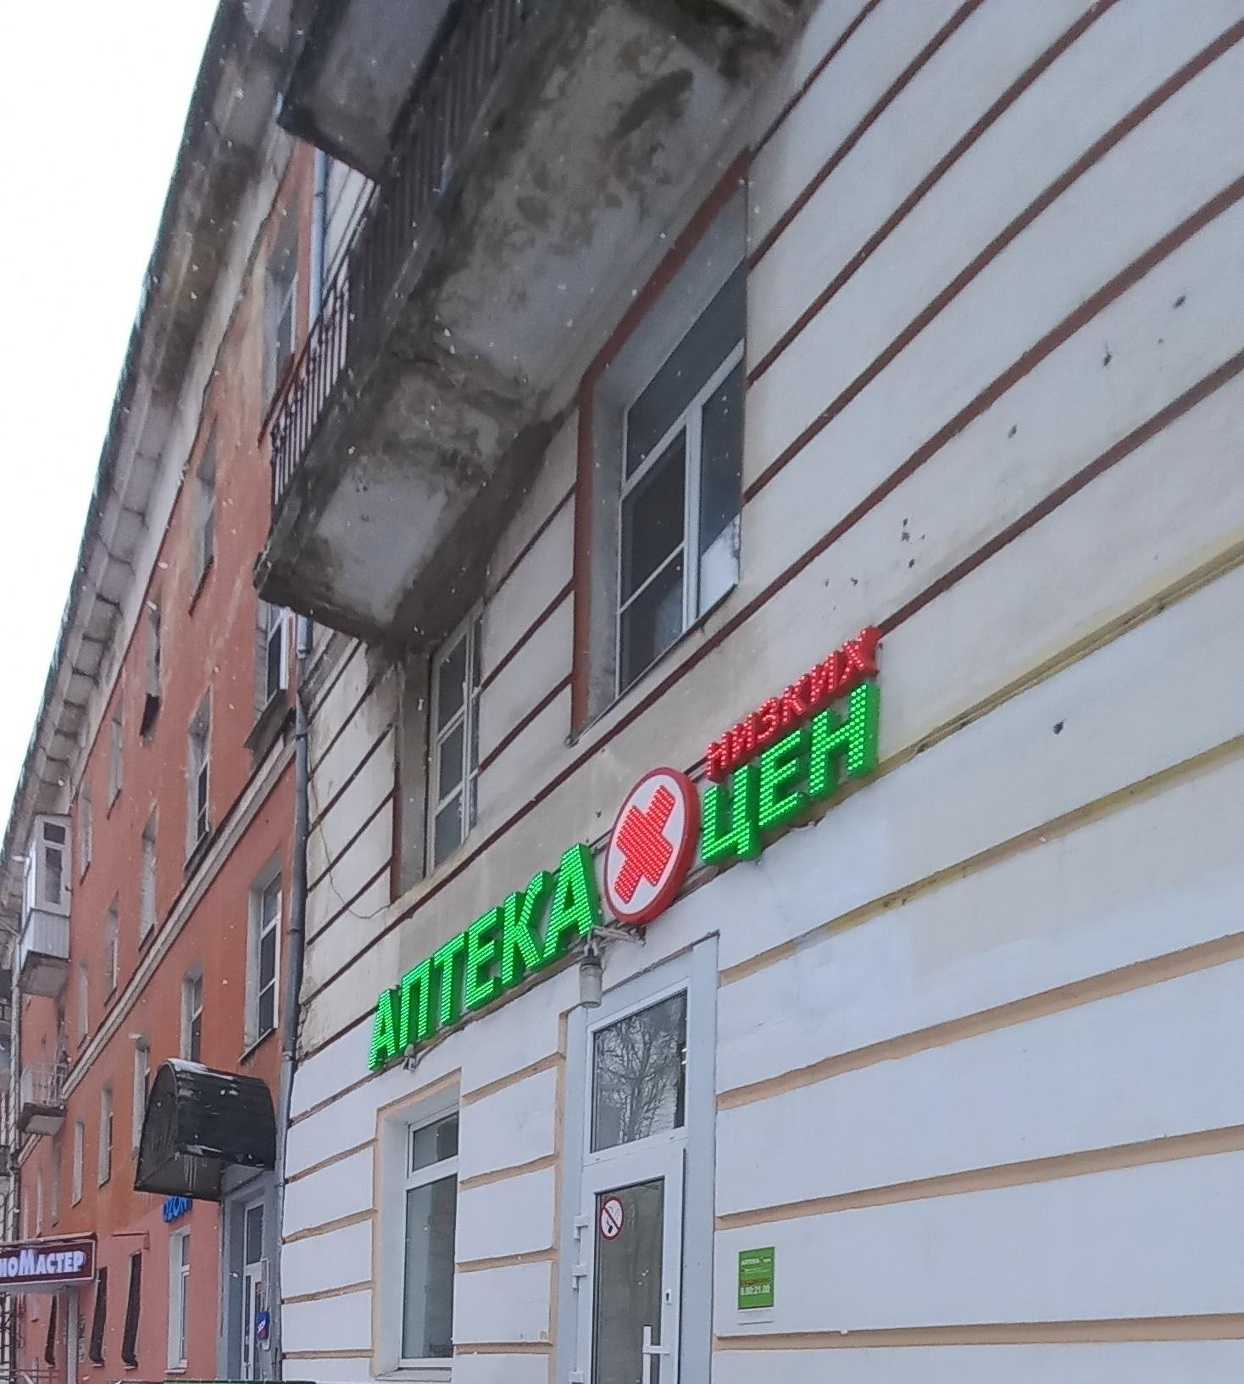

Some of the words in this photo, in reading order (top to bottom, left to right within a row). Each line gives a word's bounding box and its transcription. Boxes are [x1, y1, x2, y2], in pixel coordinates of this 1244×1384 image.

[704, 625, 882, 783] НИЗКИХ
[368, 843, 603, 1071] АПТЕКА
[701, 680, 881, 864] ЦЕН
